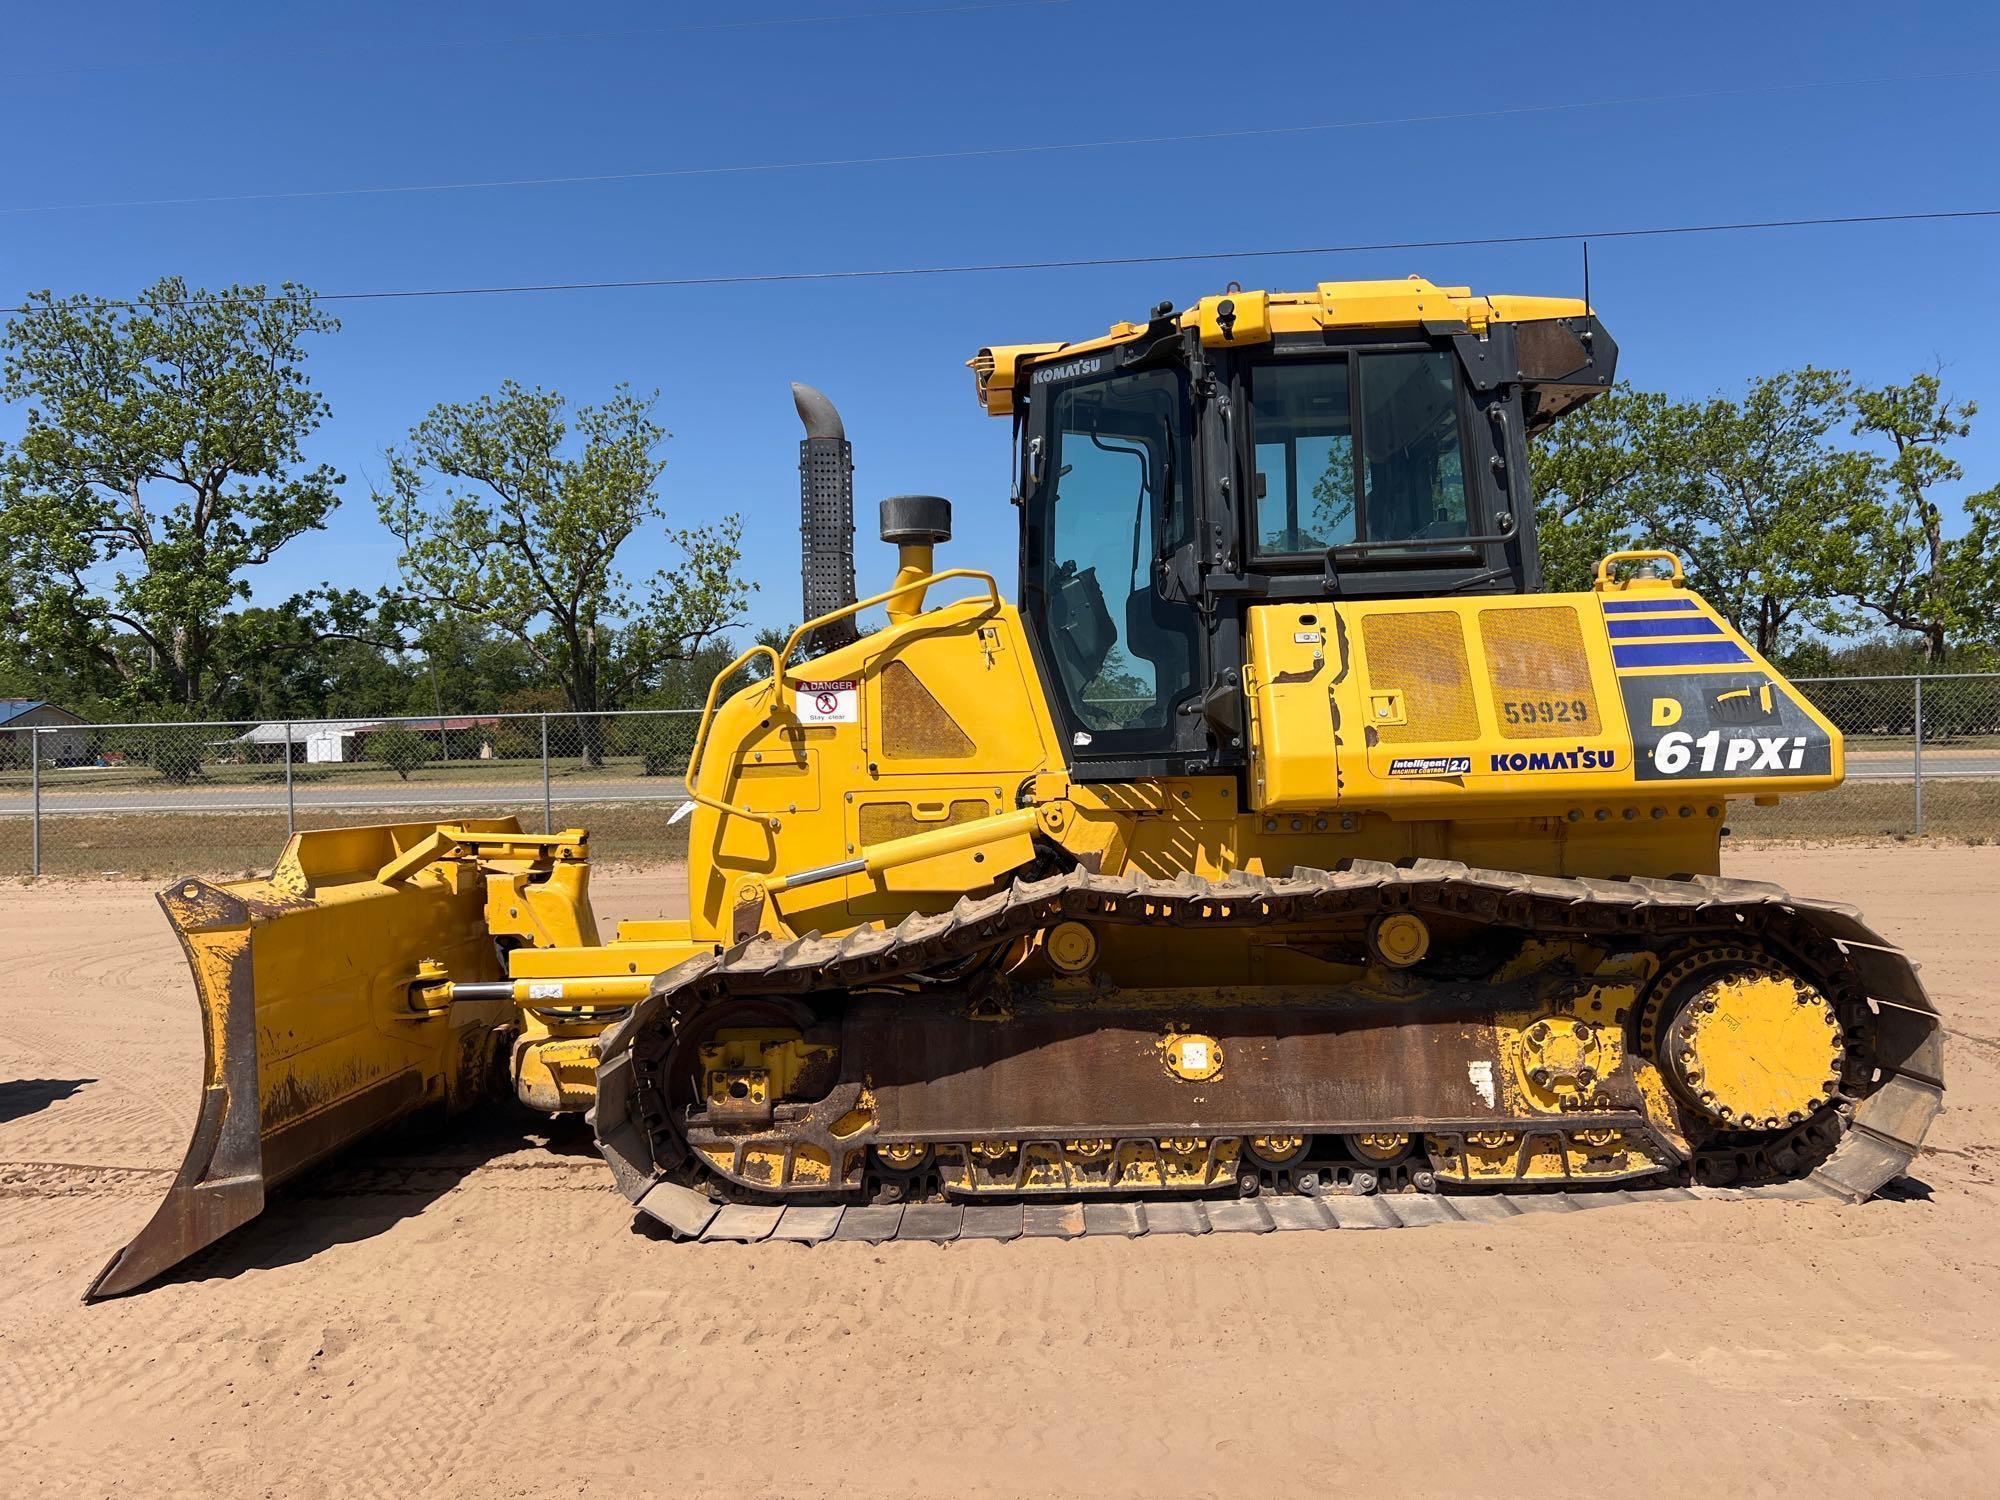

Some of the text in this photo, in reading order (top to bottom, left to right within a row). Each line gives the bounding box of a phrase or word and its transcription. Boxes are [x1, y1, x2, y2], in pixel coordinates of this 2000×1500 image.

[1033, 358, 1101, 385] KOMATSU
[810, 681, 853, 691] DANGER
[1504, 700, 1588, 724] 59929
[1651, 697, 1683, 727] D
[1491, 746, 1615, 771] KOMATSU
[1654, 730, 1807, 774] 61PXi
[1449, 759, 1470, 771] 2.0
